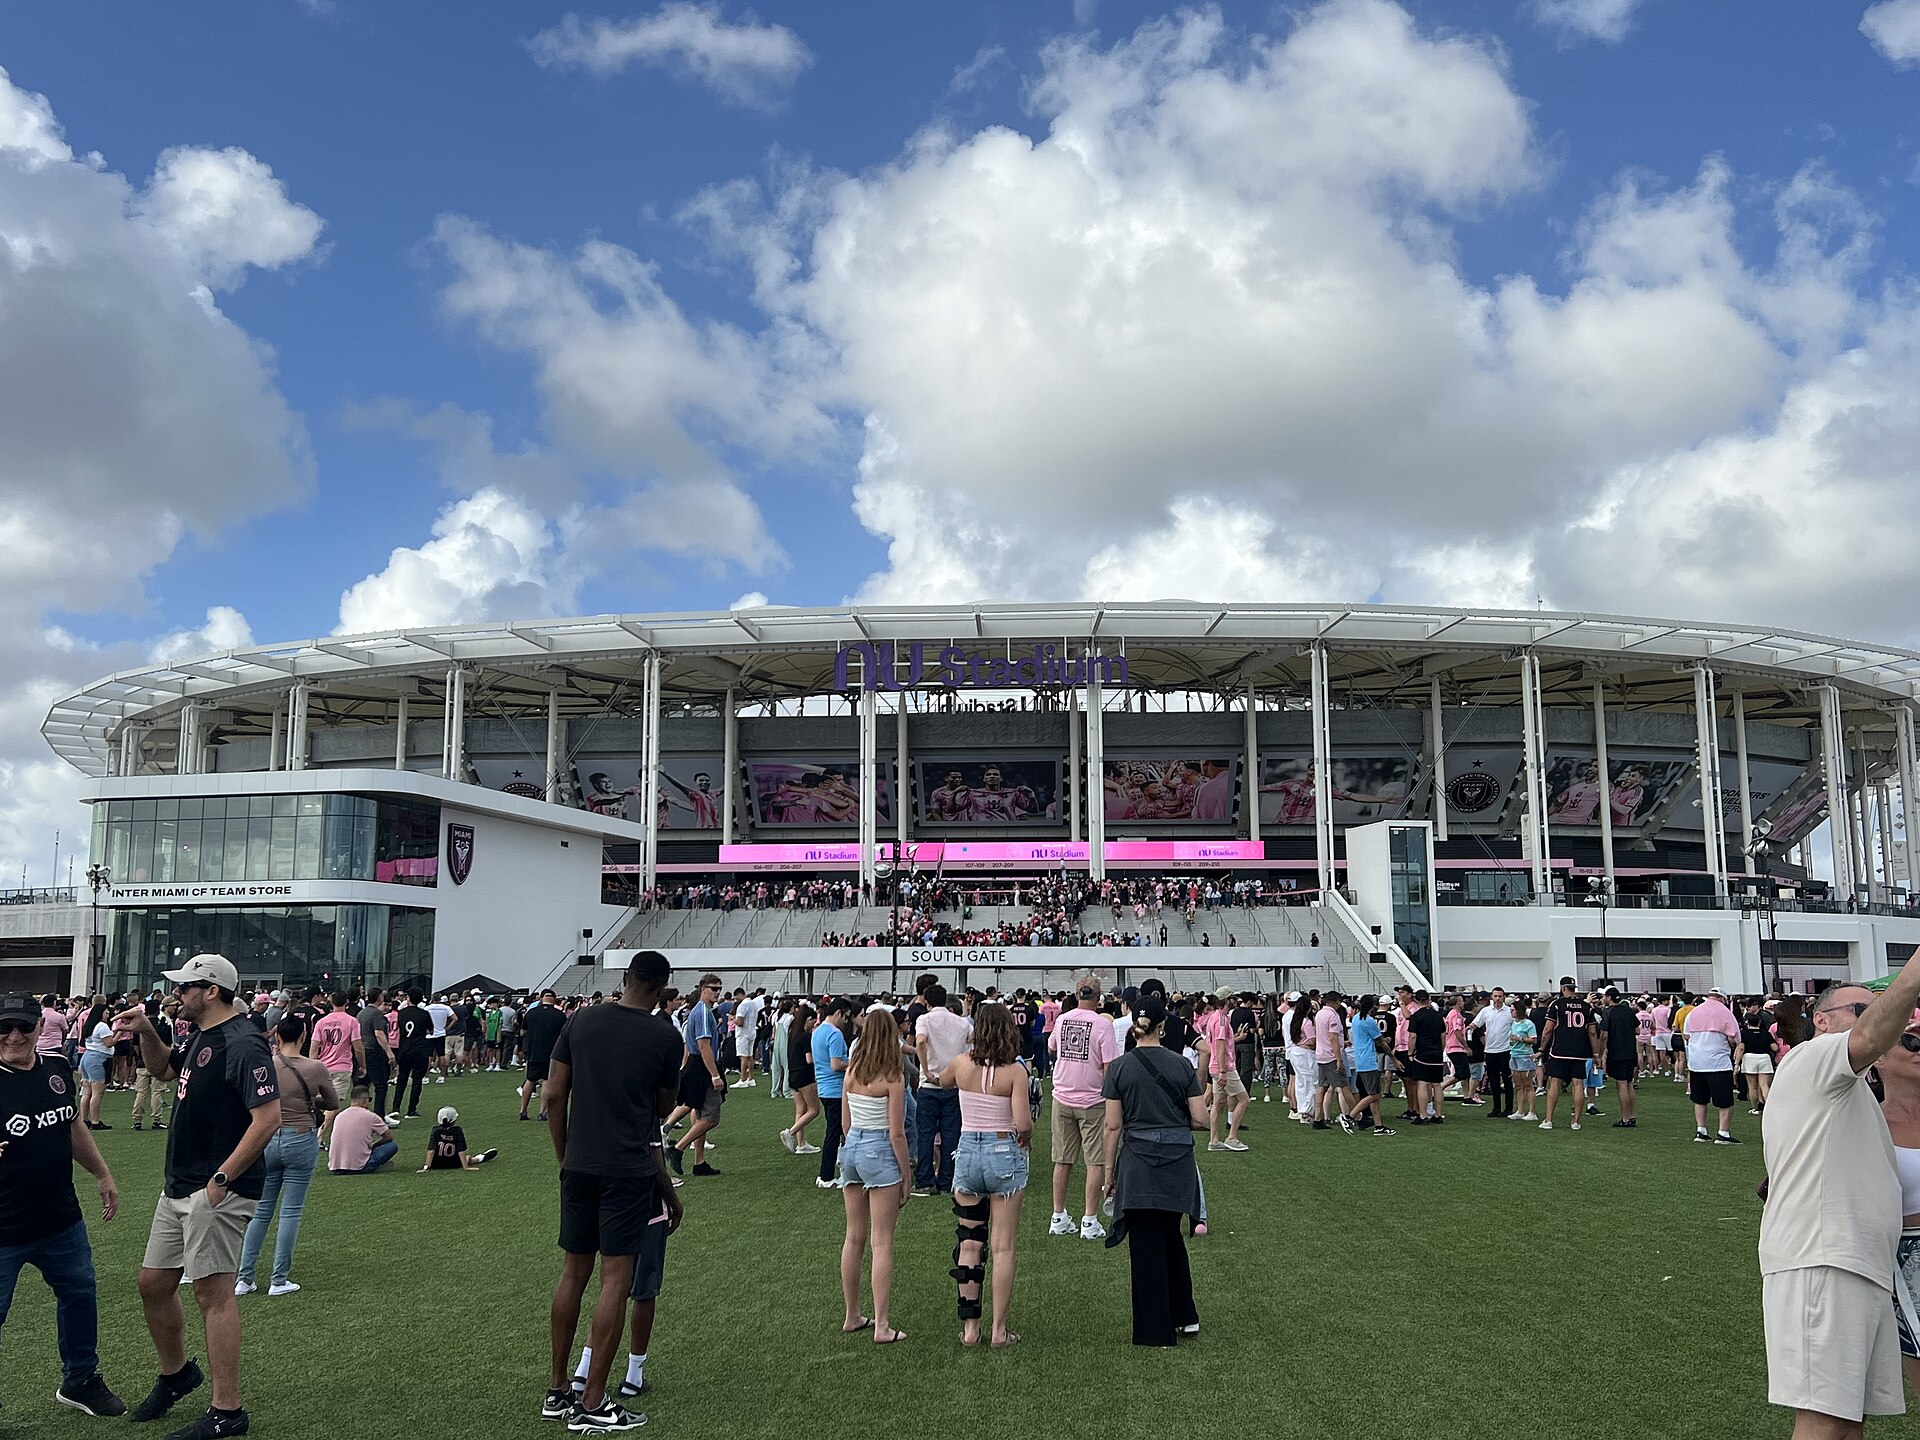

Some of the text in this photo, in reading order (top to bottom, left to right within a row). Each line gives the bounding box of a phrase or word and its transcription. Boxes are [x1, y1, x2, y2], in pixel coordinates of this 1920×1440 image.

[939, 644, 1129, 687] Stadium
[454, 830, 472, 839] MIAMI
[823, 850, 858, 860] Stadium
[1050, 849, 1085, 858] Stadium
[1212, 849, 1239, 857] Stadium
[111, 886, 292, 898] INTER MIAMI CF TEAM STORE
[911, 950, 1006, 962] SOUTH GATE
[1012, 1012, 1027, 1026] 10
[1565, 1010, 1585, 1028] 10
[1641, 1019, 1651, 1029] 10
[405, 1020, 415, 1038] 9
[323, 1028, 343, 1046] 10
[264, 1085, 275, 1095] tv
[34, 1105, 79, 1129] XBTO
[437, 1141, 456, 1157] 10
